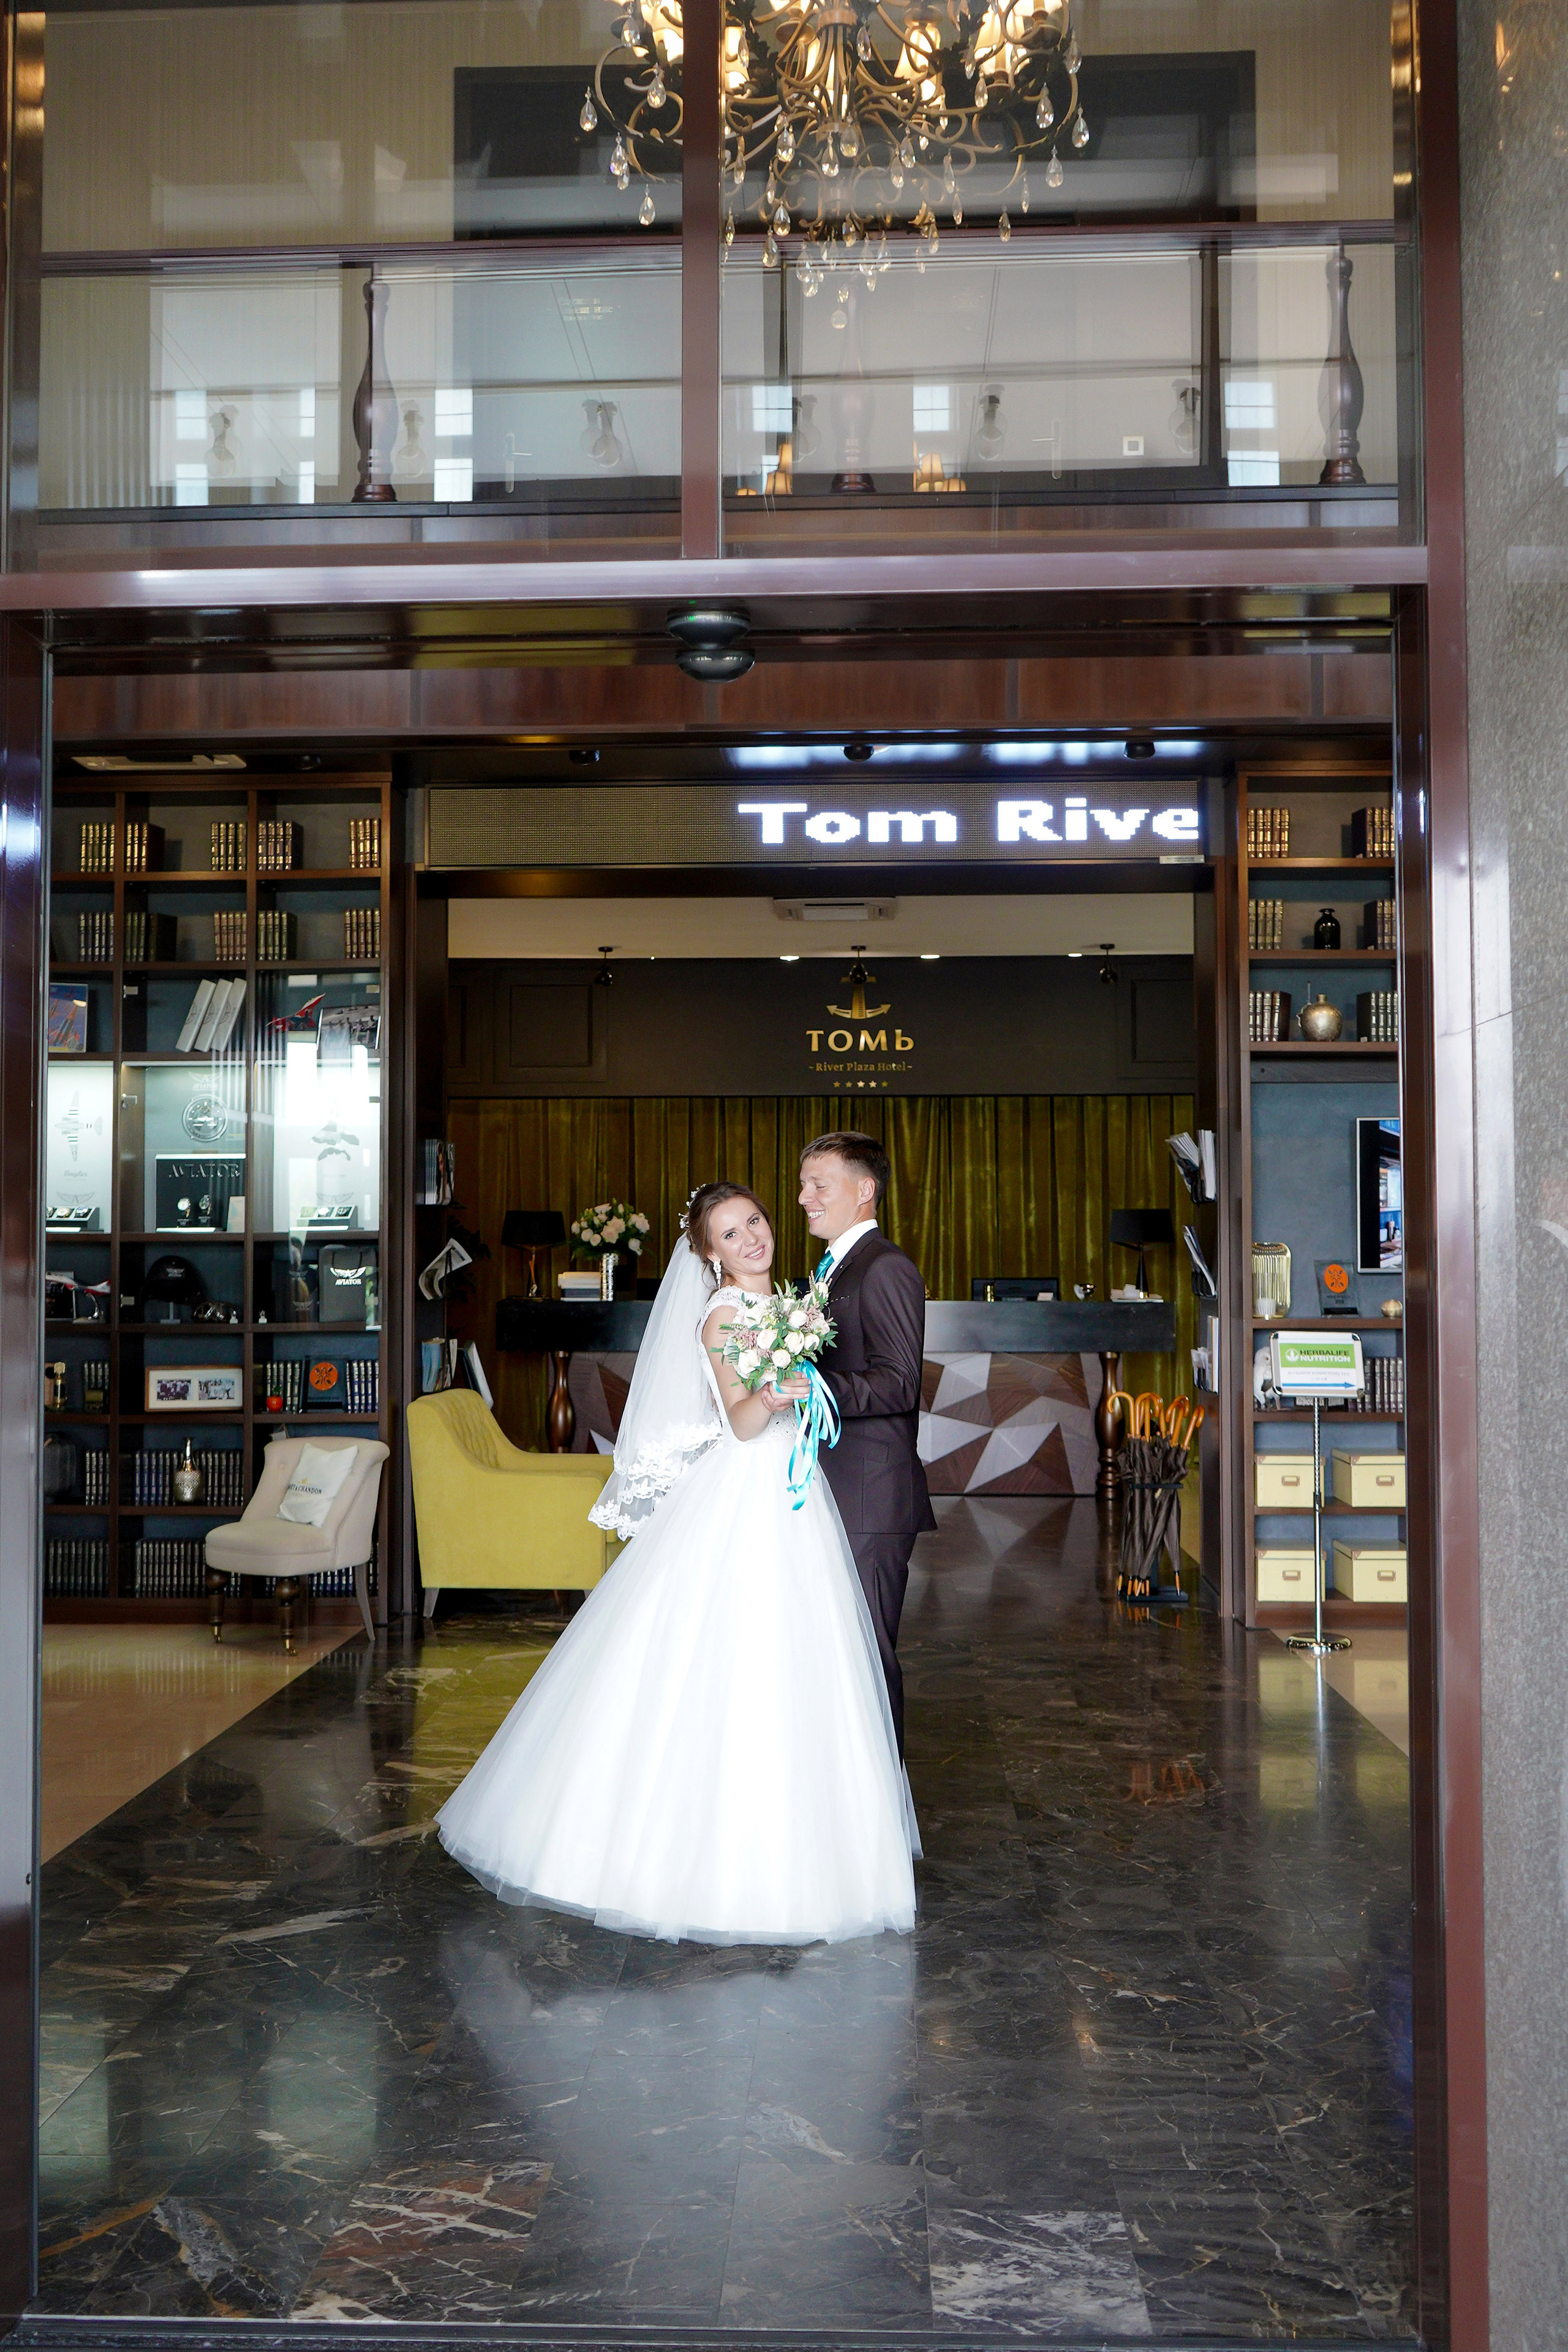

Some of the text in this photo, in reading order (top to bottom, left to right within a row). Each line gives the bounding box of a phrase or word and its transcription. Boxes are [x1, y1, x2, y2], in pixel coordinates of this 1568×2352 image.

[737, 798, 1199, 844] Tom Rive
[805, 1029, 914, 1052] ТОМЬ
[816, 1062, 843, 1071] River
[846, 1061, 875, 1071] Plaza
